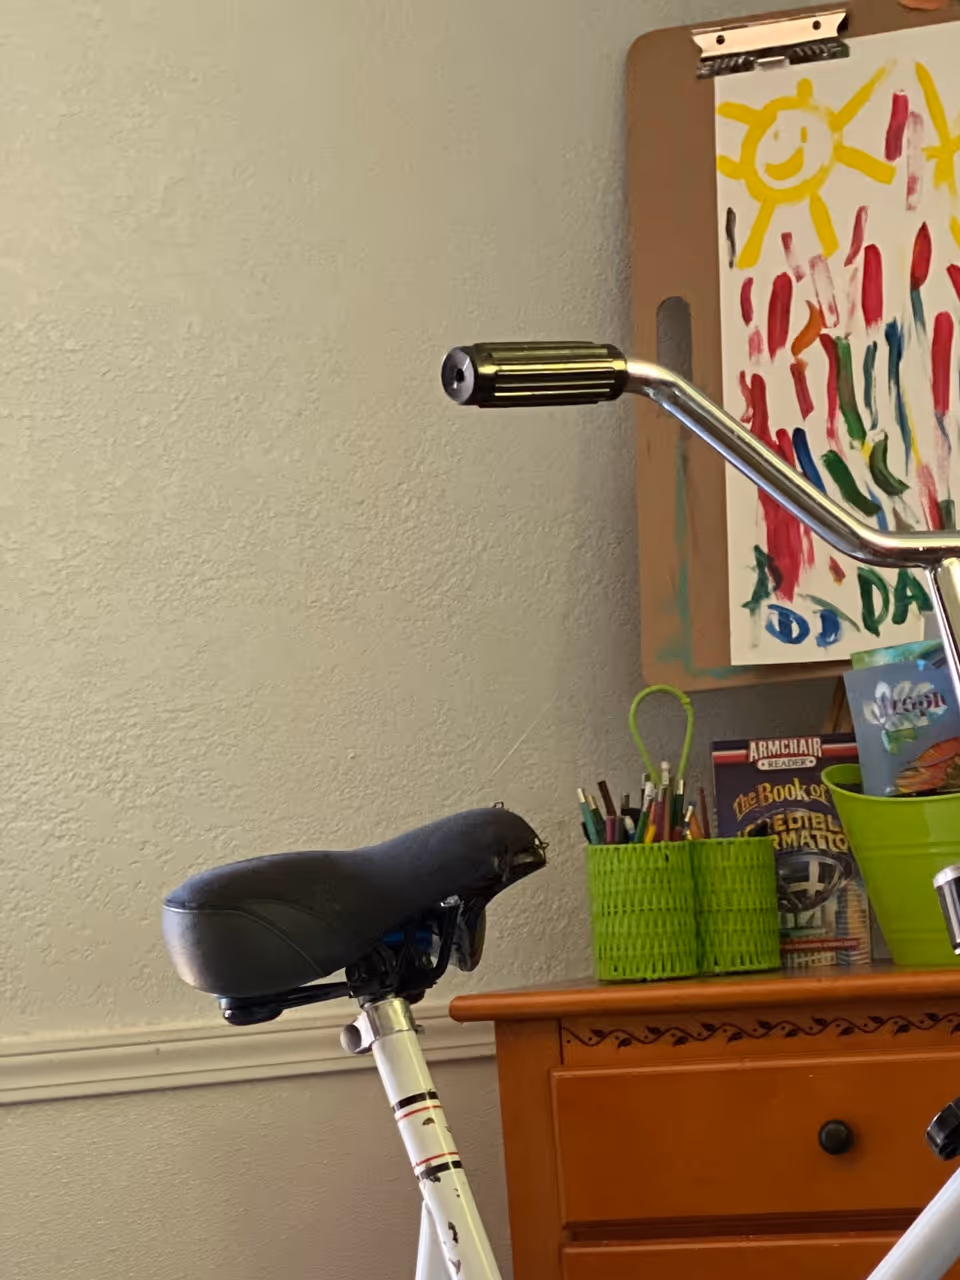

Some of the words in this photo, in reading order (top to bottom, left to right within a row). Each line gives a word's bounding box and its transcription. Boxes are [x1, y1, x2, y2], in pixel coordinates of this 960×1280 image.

[750, 737, 822, 762] ARMCHAIR
[767, 756, 808, 768] READER
[733, 791, 758, 822] The
[758, 777, 808, 806] Book
[809, 783, 832, 806] of
[772, 829, 849, 854] RMATIO
